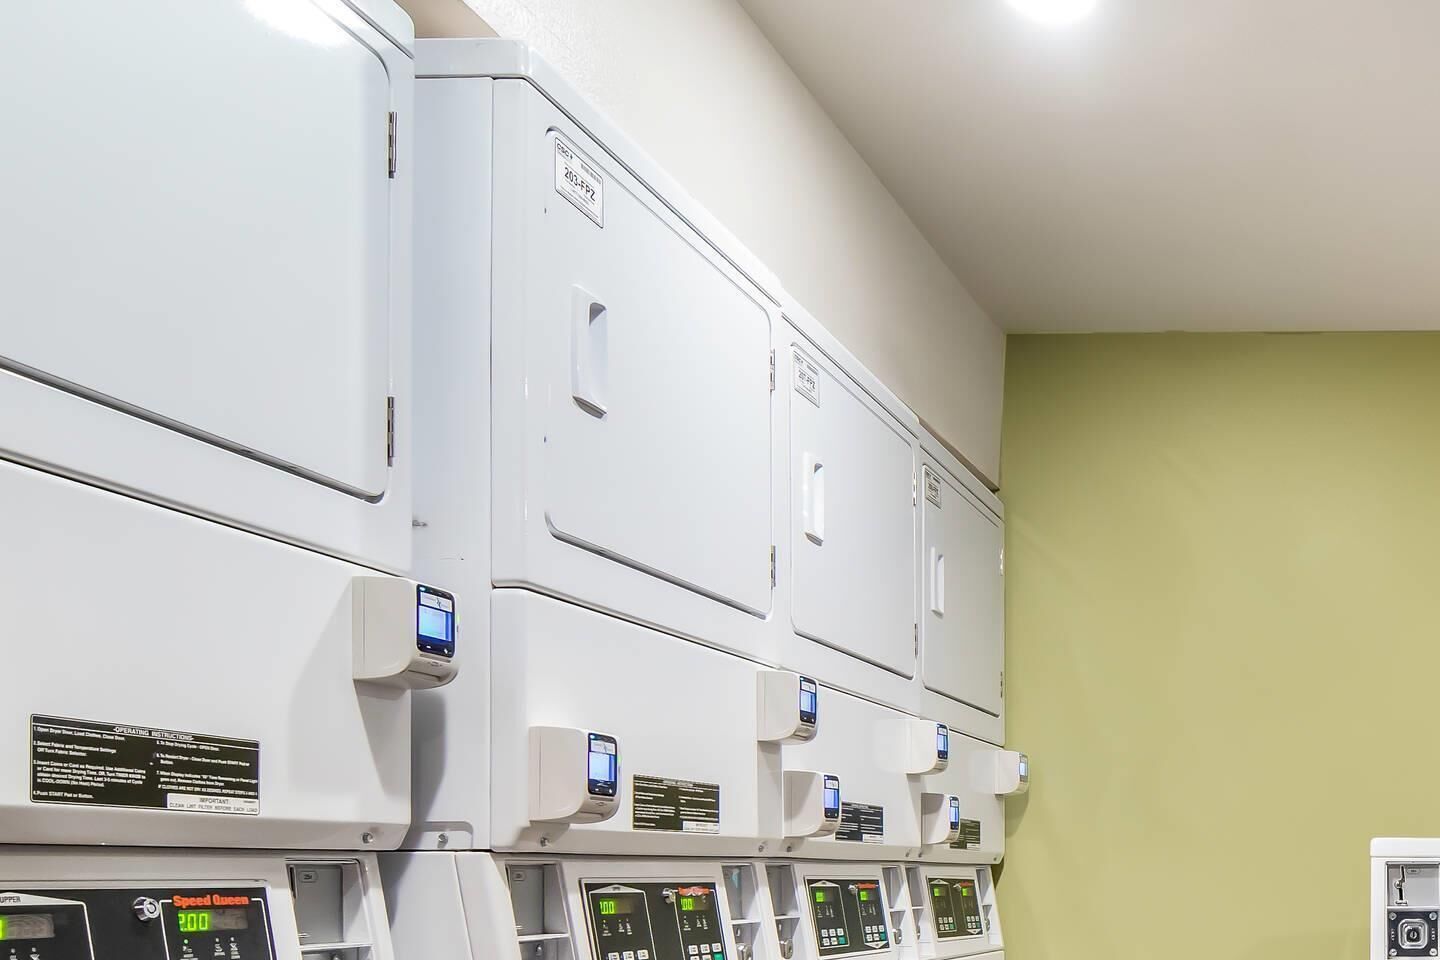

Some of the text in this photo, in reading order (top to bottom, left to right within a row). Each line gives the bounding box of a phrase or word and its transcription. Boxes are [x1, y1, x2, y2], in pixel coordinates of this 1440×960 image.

[564, 167, 596, 202] 203-FPZ
[115, 726, 193, 740] OPERATING INSTRUCTIONS
[173, 894, 250, 908] Speed Queen
